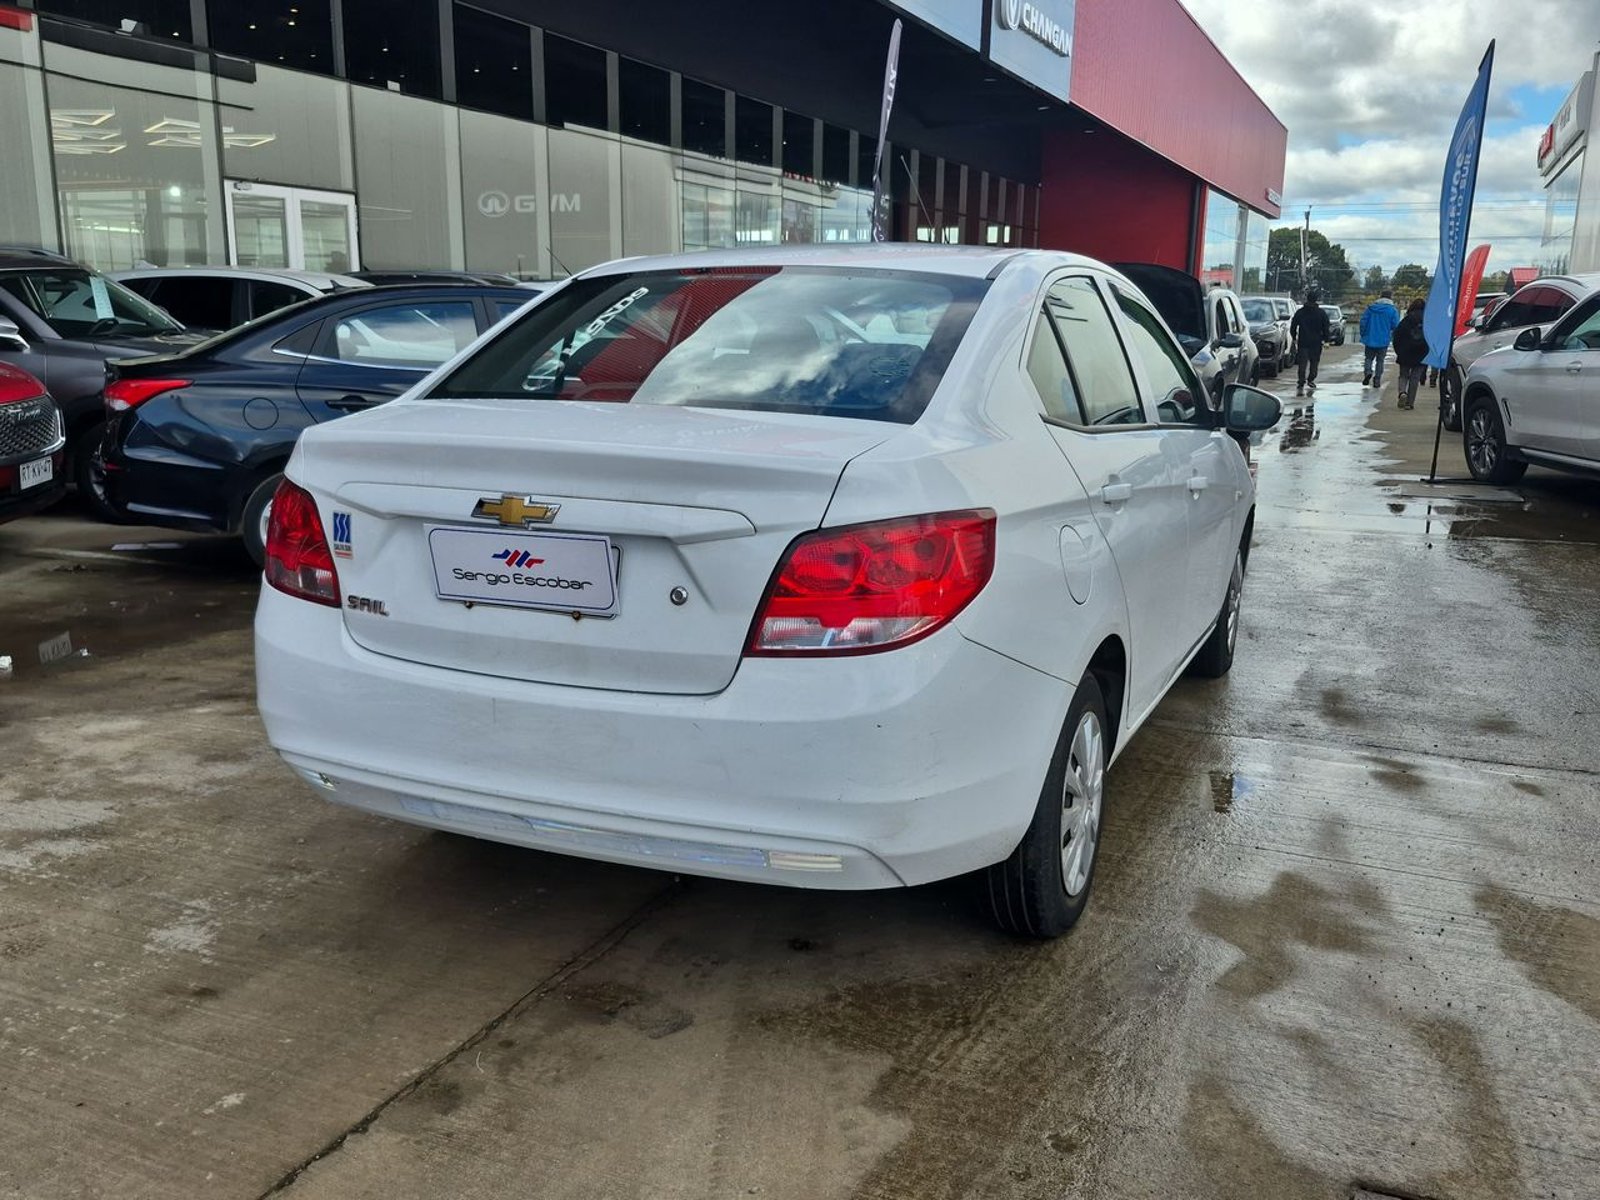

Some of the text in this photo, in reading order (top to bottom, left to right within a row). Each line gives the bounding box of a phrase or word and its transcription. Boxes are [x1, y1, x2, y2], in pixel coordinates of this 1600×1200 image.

[1022, 2, 1073, 57] CHANGAN
[514, 193, 581, 213] GM
[512, 573, 593, 591] Escobar
[347, 594, 390, 617] SAIL
